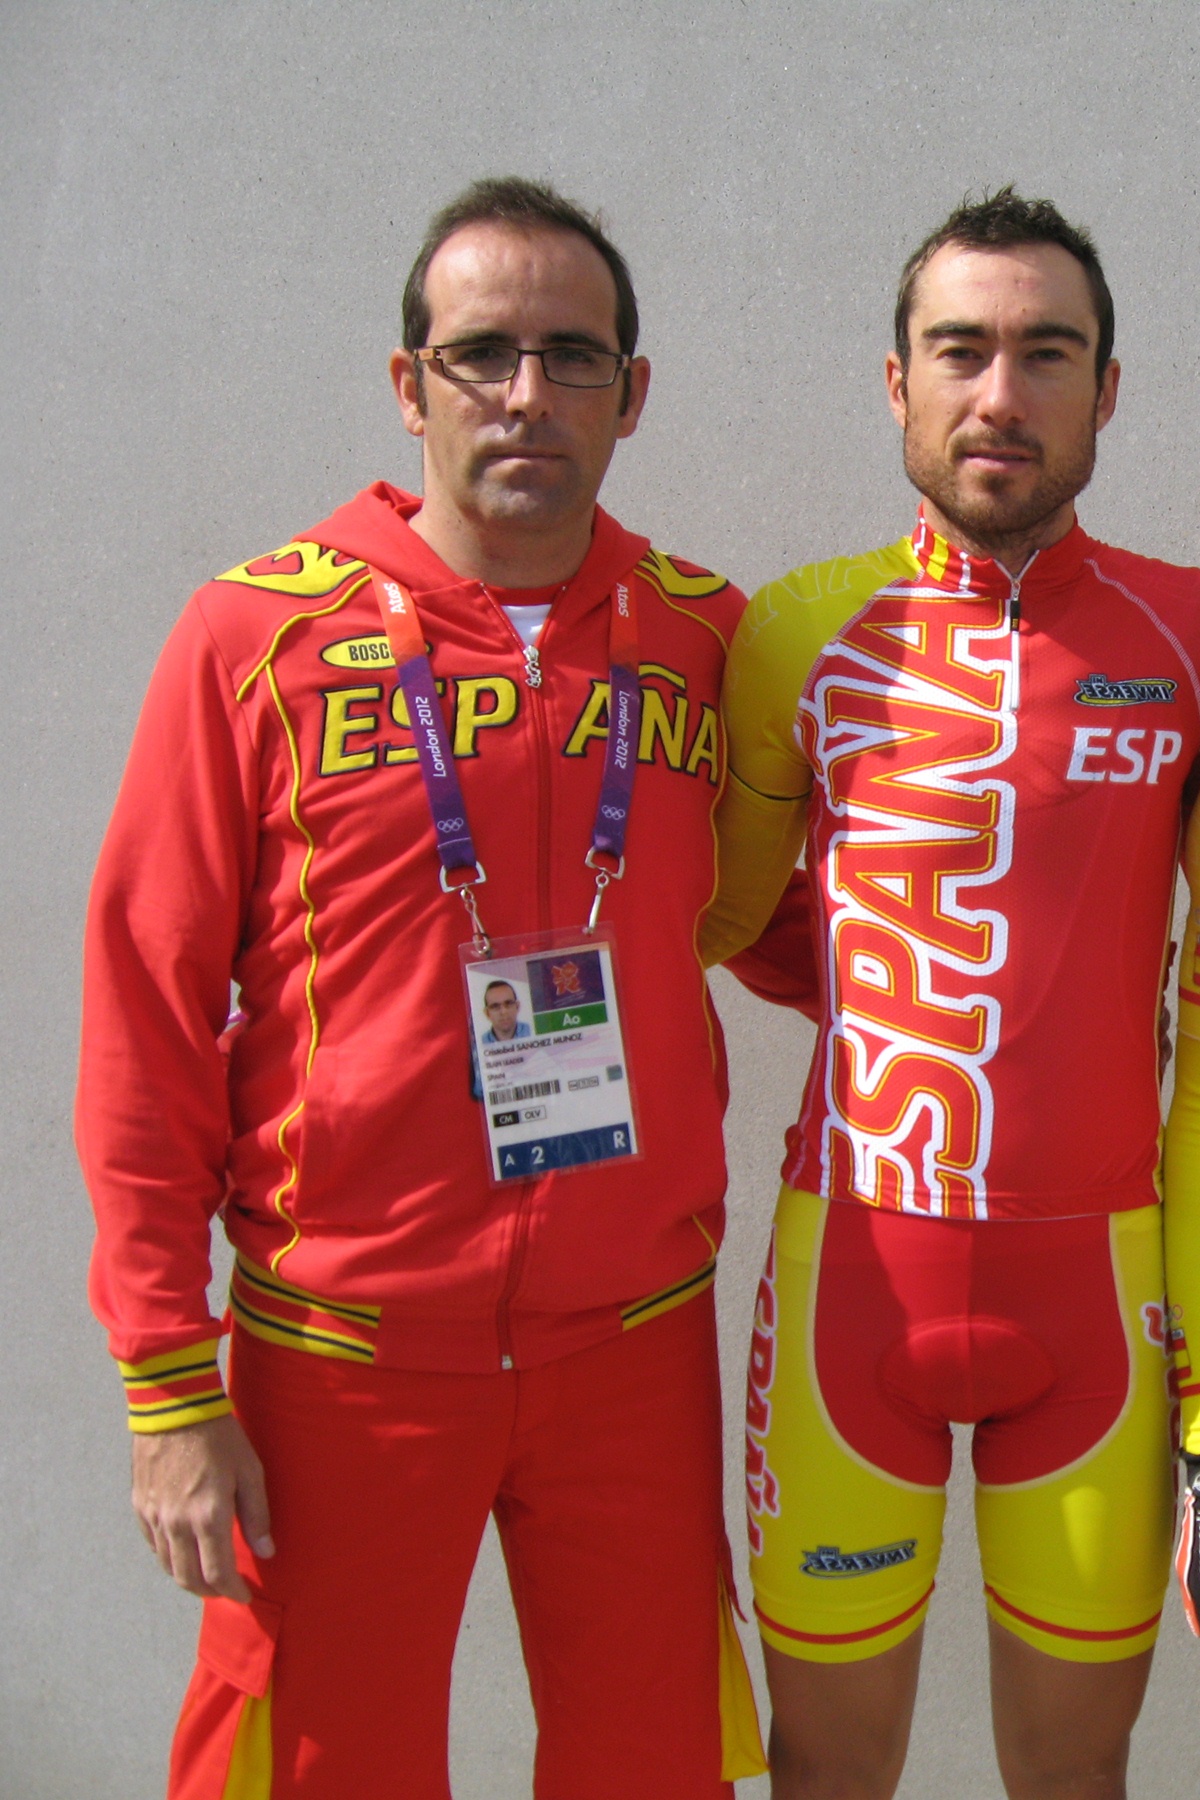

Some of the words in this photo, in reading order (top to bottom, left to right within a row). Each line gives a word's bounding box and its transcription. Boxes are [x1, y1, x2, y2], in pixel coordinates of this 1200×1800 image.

[383, 583, 407, 615] Atos
[616, 582, 630, 618] Atos
[347, 642, 391, 662] BOSC
[415, 696, 434, 726] 2012
[617, 690, 631, 736] London
[426, 728, 447, 777] London
[614, 737, 629, 769] 2012
[1066, 726, 1183, 785] ESP
[516, 1038, 552, 1051] SANCHEZ
[504, 1153, 515, 1167] A
[531, 1145, 546, 1165] 2
[612, 1130, 627, 1149] R
